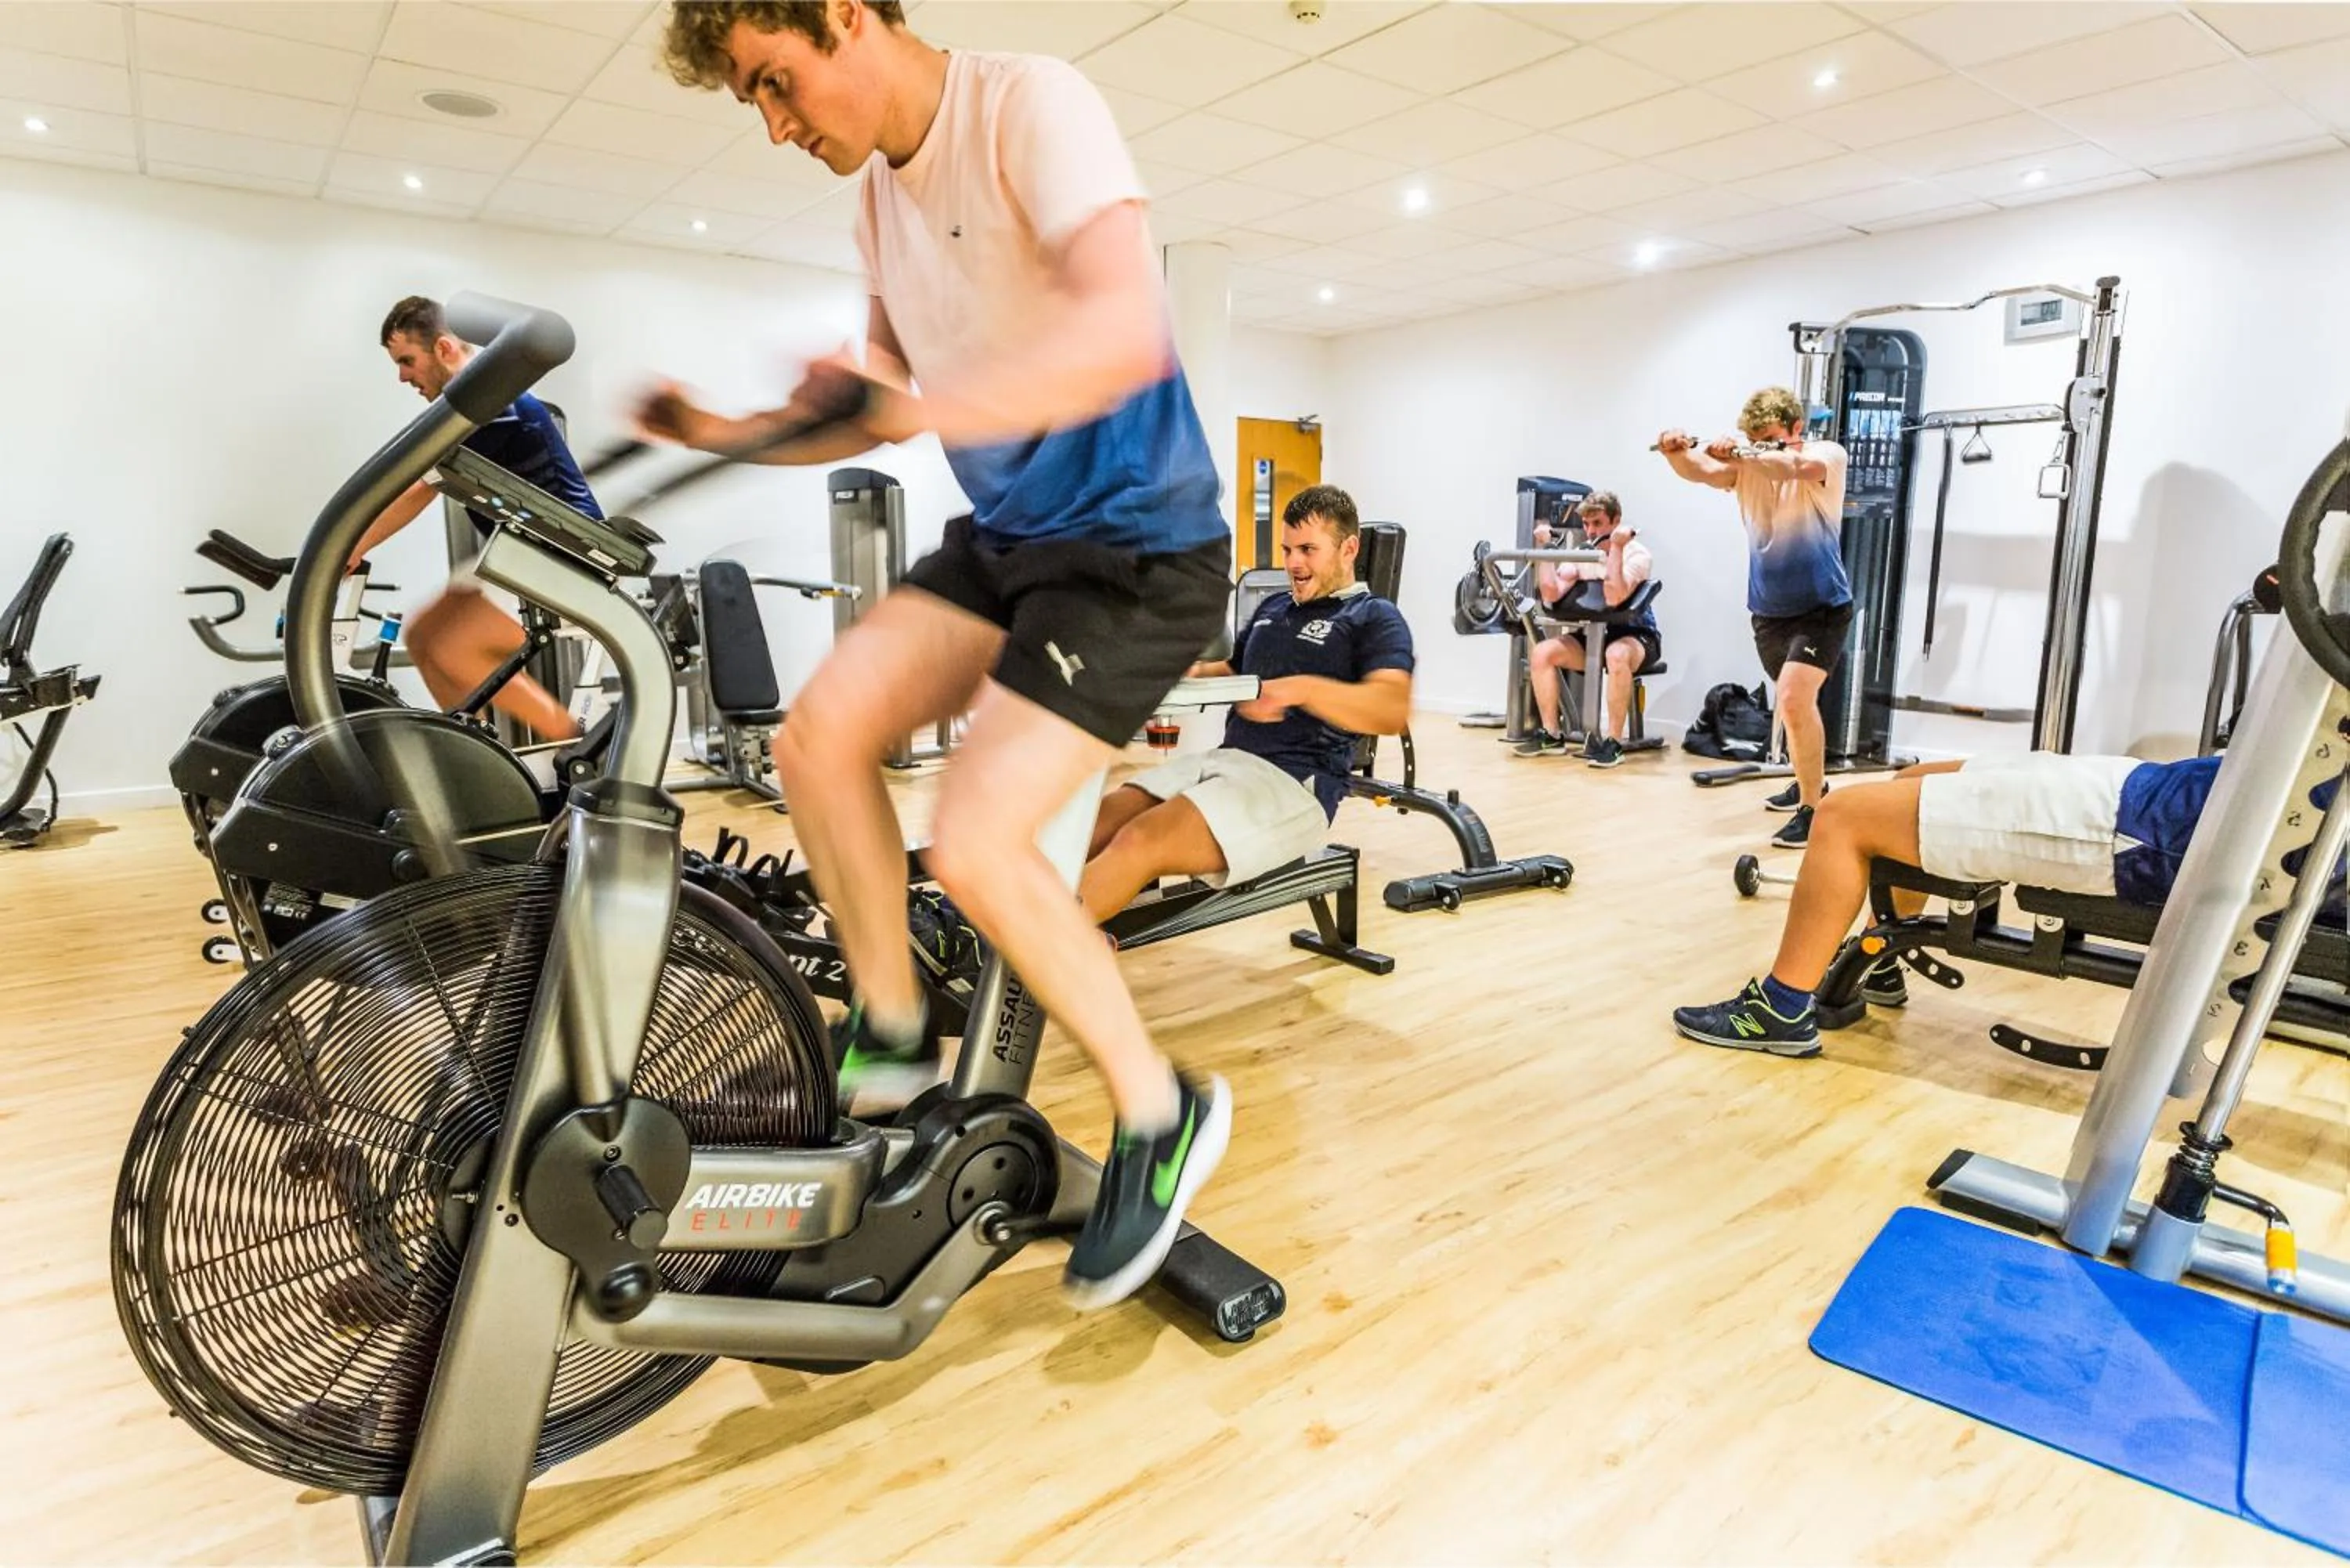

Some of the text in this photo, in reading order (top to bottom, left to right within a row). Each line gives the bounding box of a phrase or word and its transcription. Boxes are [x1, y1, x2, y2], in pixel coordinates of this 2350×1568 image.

[825, 960, 846, 981] 2
[685, 1183, 822, 1209] AIRBIKE
[690, 1209, 803, 1232] ELITE
